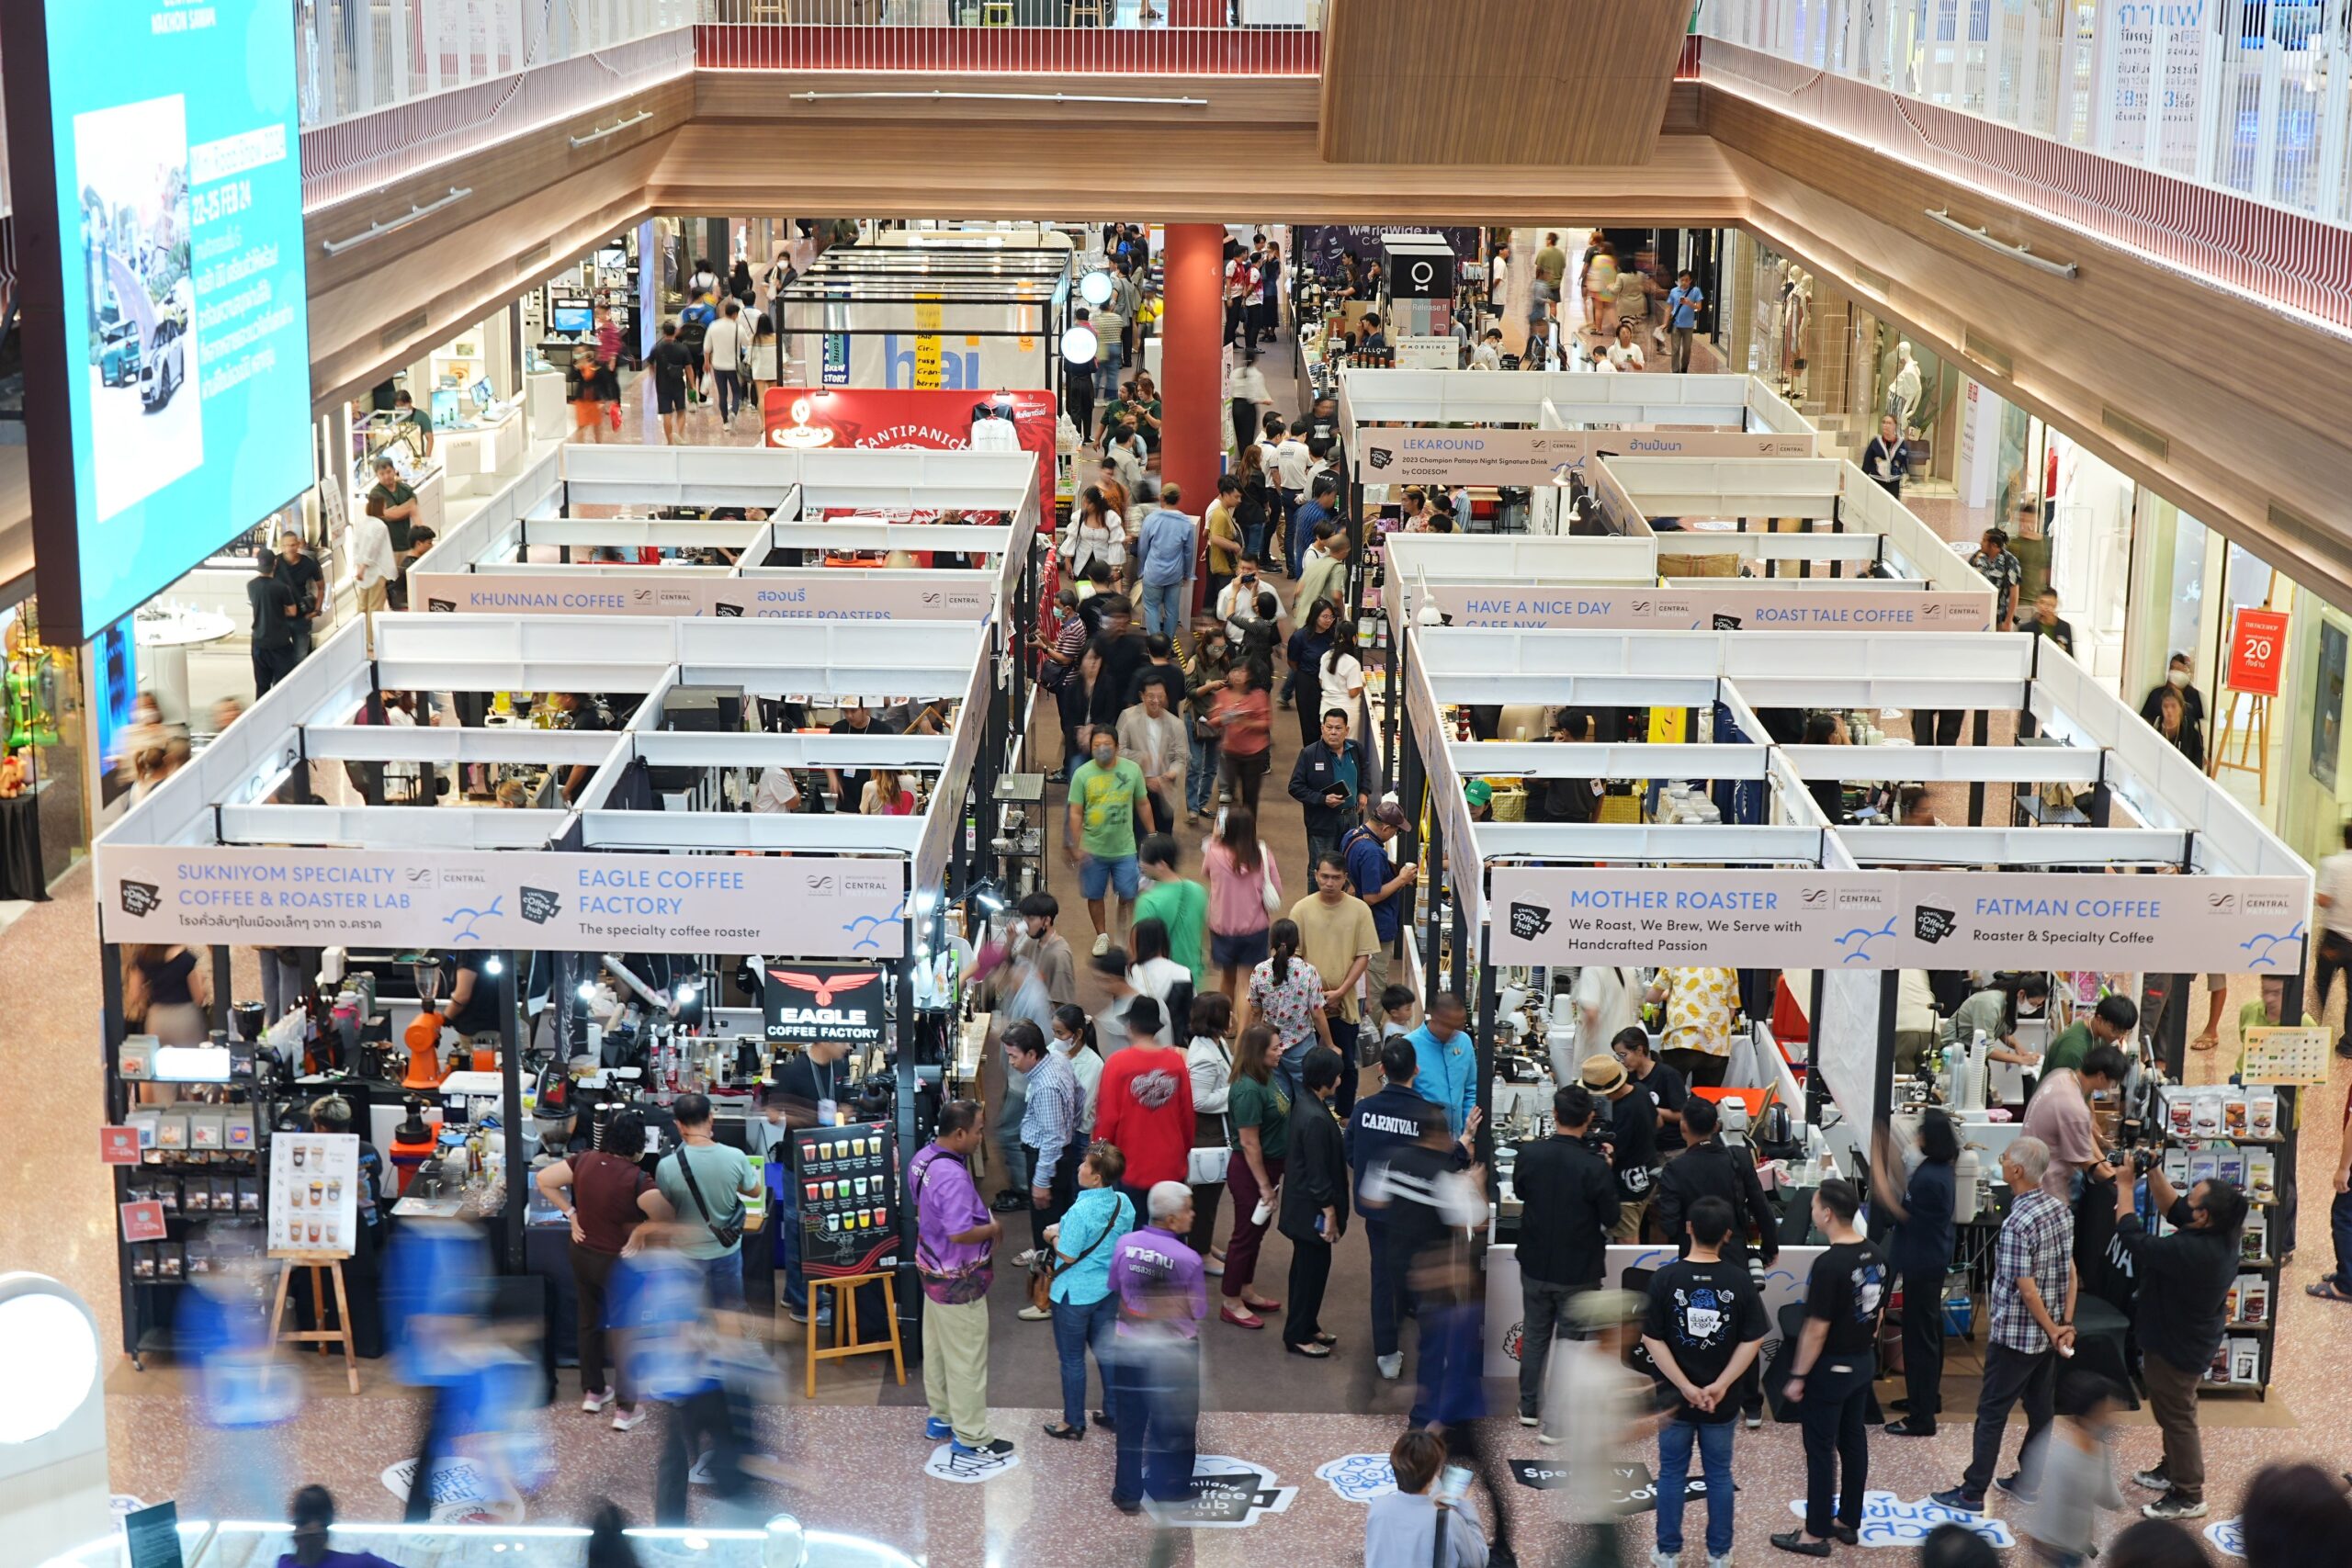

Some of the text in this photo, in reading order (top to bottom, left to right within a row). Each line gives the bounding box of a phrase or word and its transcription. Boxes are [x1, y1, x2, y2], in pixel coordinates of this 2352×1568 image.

[1403, 439, 1485, 450] LEKAROUND
[470, 592, 625, 608] KHUNNAN COFFEE
[1467, 600, 1611, 615] HAVE A NICE DAY
[1756, 608, 1914, 622] ROAST TALE COFFEE
[177, 864, 396, 883] SUKNIYOM SPECIALTY
[443, 874, 486, 883] CENTRAL
[579, 869, 744, 889] EAGLE COFFEE
[178, 889, 411, 909] COFFEE & ROASTER LAB
[580, 897, 684, 915] FACTORY
[1571, 891, 1778, 909] MOTHER ROASTER
[1839, 895, 1883, 903] CENTRAL
[526, 904, 544, 916] hub
[1517, 908, 1541, 919] Thailand
[1976, 898, 2161, 918] FATMAN COFFEE
[313, 920, 335, 929] จาก
[1516, 920, 1532, 931] hub
[1569, 919, 1802, 932] We Roast, We Brew, We Serve with
[1920, 923, 1937, 935] hub
[579, 923, 761, 942] The specialty coffee roaster
[1973, 930, 2154, 945] Roaster & Specialty Coffee
[1568, 939, 1707, 951] Handcrafted Passion
[781, 1008, 867, 1025] EAGLE
[767, 1026, 879, 1038] COFFEE FACTORY
[1362, 1112, 1419, 1136] CARNIVAL
[1125, 1245, 1175, 1269] พาสาน
[1201, 1489, 1248, 1500] ffee
[1193, 1499, 1229, 1510] ub
